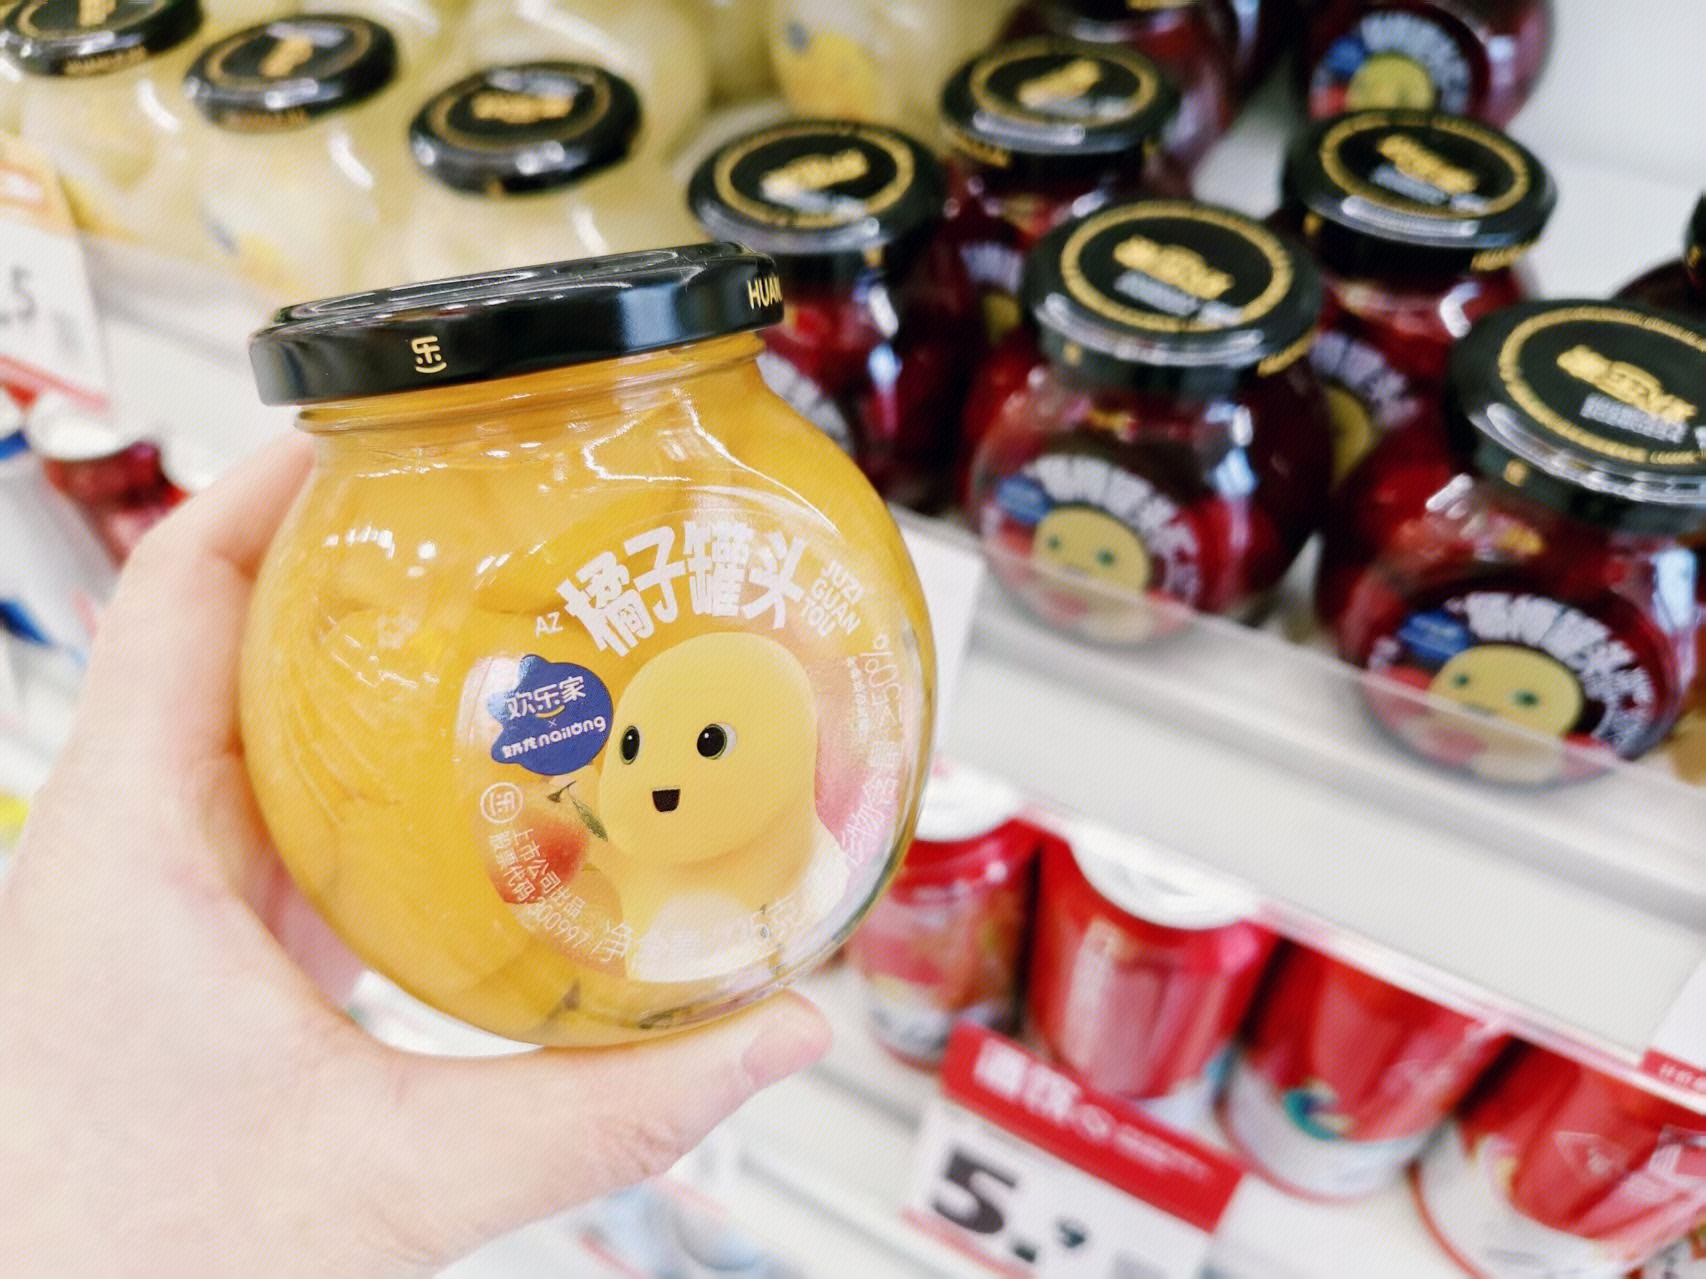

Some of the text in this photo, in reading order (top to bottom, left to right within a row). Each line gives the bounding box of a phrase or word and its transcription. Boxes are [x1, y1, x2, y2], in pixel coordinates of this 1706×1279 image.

[556, 520, 808, 657] 橘子罐头
[811, 578, 860, 635] GUAN
[535, 612, 564, 636] AZ
[507, 676, 587, 720] 欢乐家
[514, 828, 586, 919] 上市公司出品
